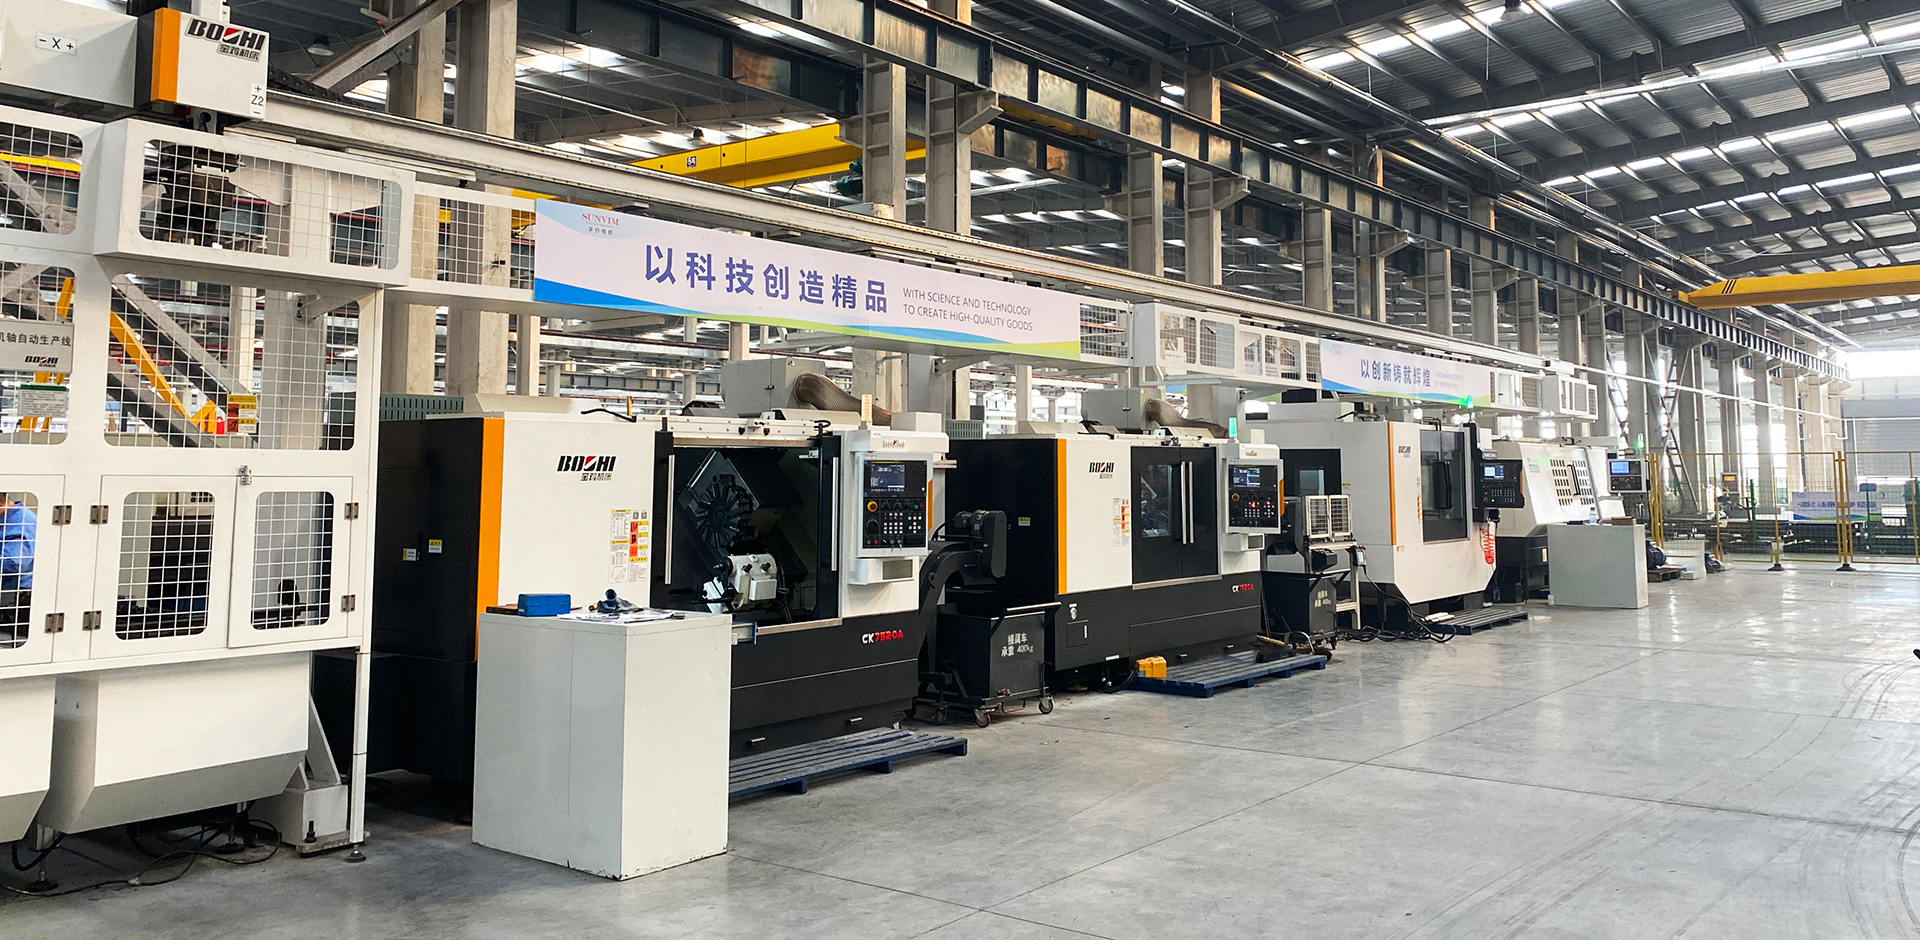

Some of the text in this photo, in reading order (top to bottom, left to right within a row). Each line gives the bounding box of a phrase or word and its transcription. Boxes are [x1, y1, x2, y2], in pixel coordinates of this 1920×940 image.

[250, 94, 265, 107] Z2
[581, 212, 619, 226] SUNVIM
[644, 244, 888, 313] 以科技创造精品
[903, 287, 1032, 317] WITH SCIENCE AND TECHNOLOGY
[903, 303, 1034, 332] TO CREATE HIGH-QUALITY GOODS
[1360, 358, 1431, 387] 以创新铸就辉煌
